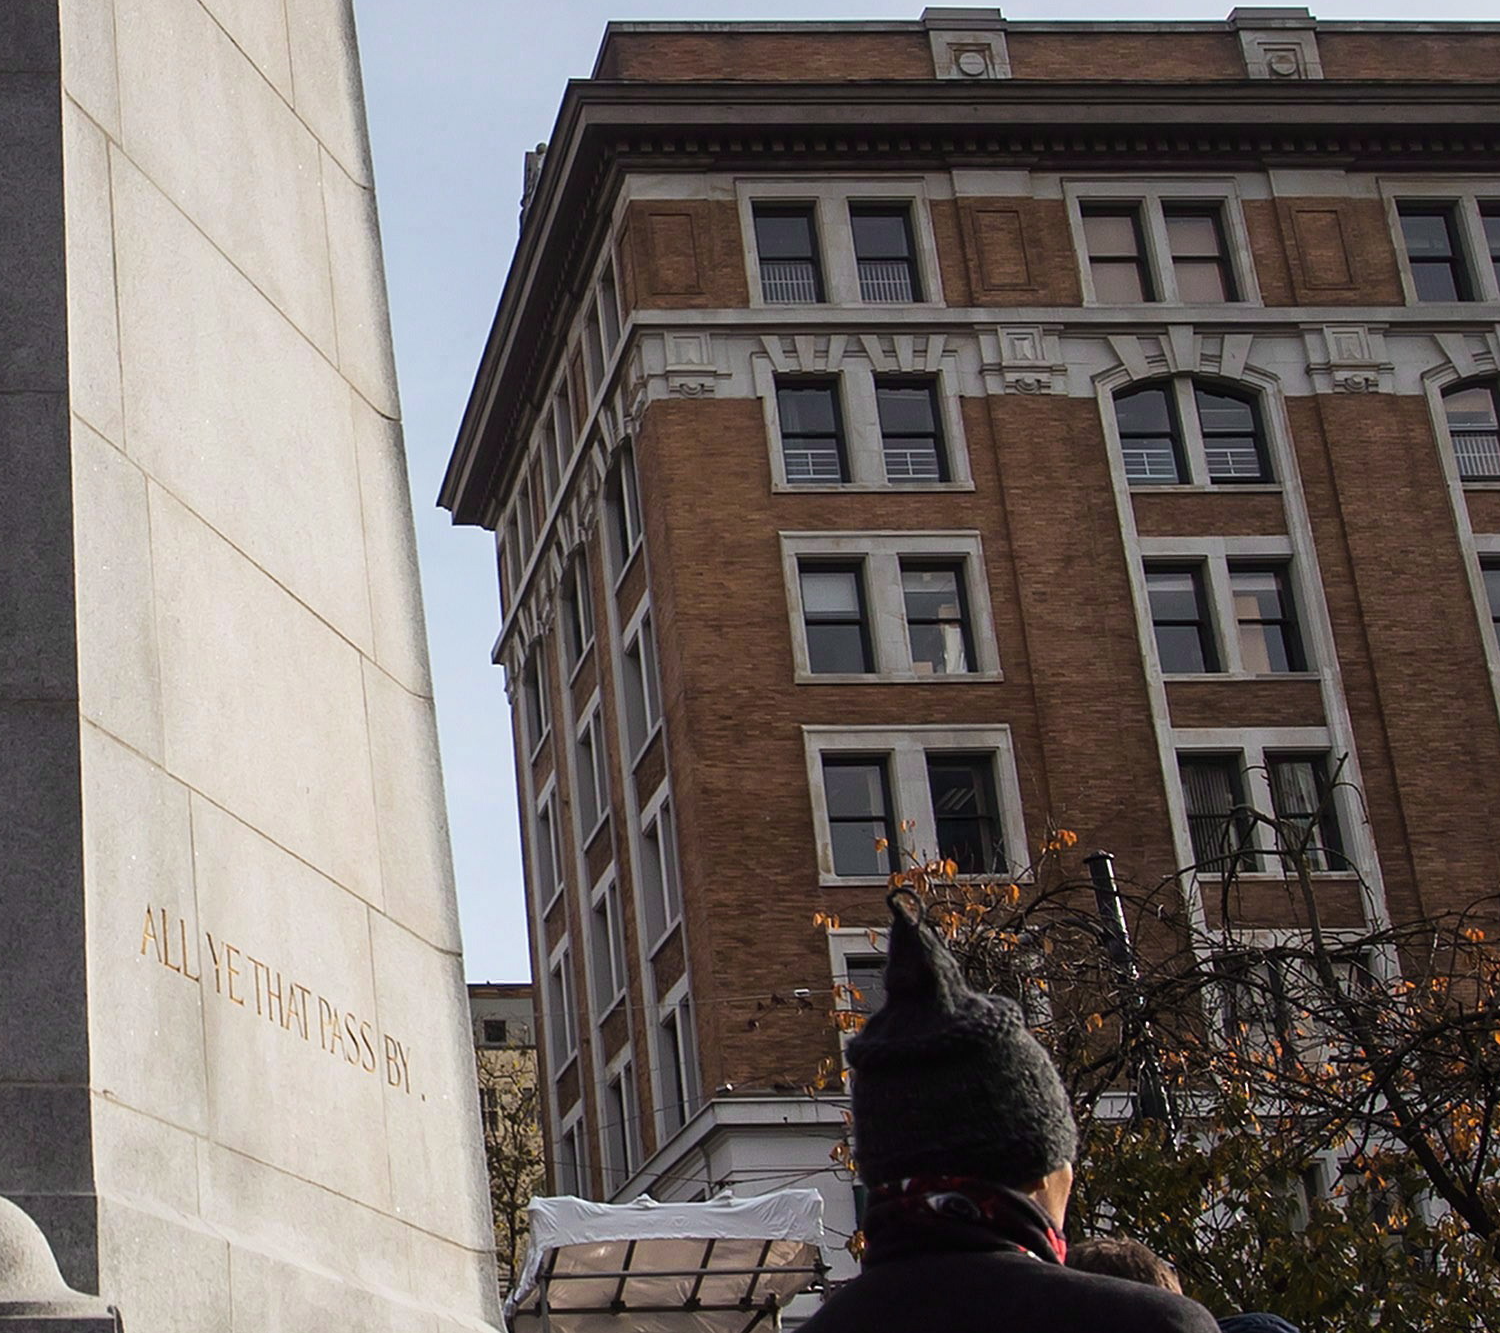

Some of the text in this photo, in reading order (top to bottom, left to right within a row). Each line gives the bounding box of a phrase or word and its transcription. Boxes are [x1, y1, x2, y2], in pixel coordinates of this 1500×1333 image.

[140, 902, 200, 982] ALL
[205, 931, 244, 1006] YE
[247, 955, 311, 1041] THAT
[317, 995, 377, 1074] PASS
